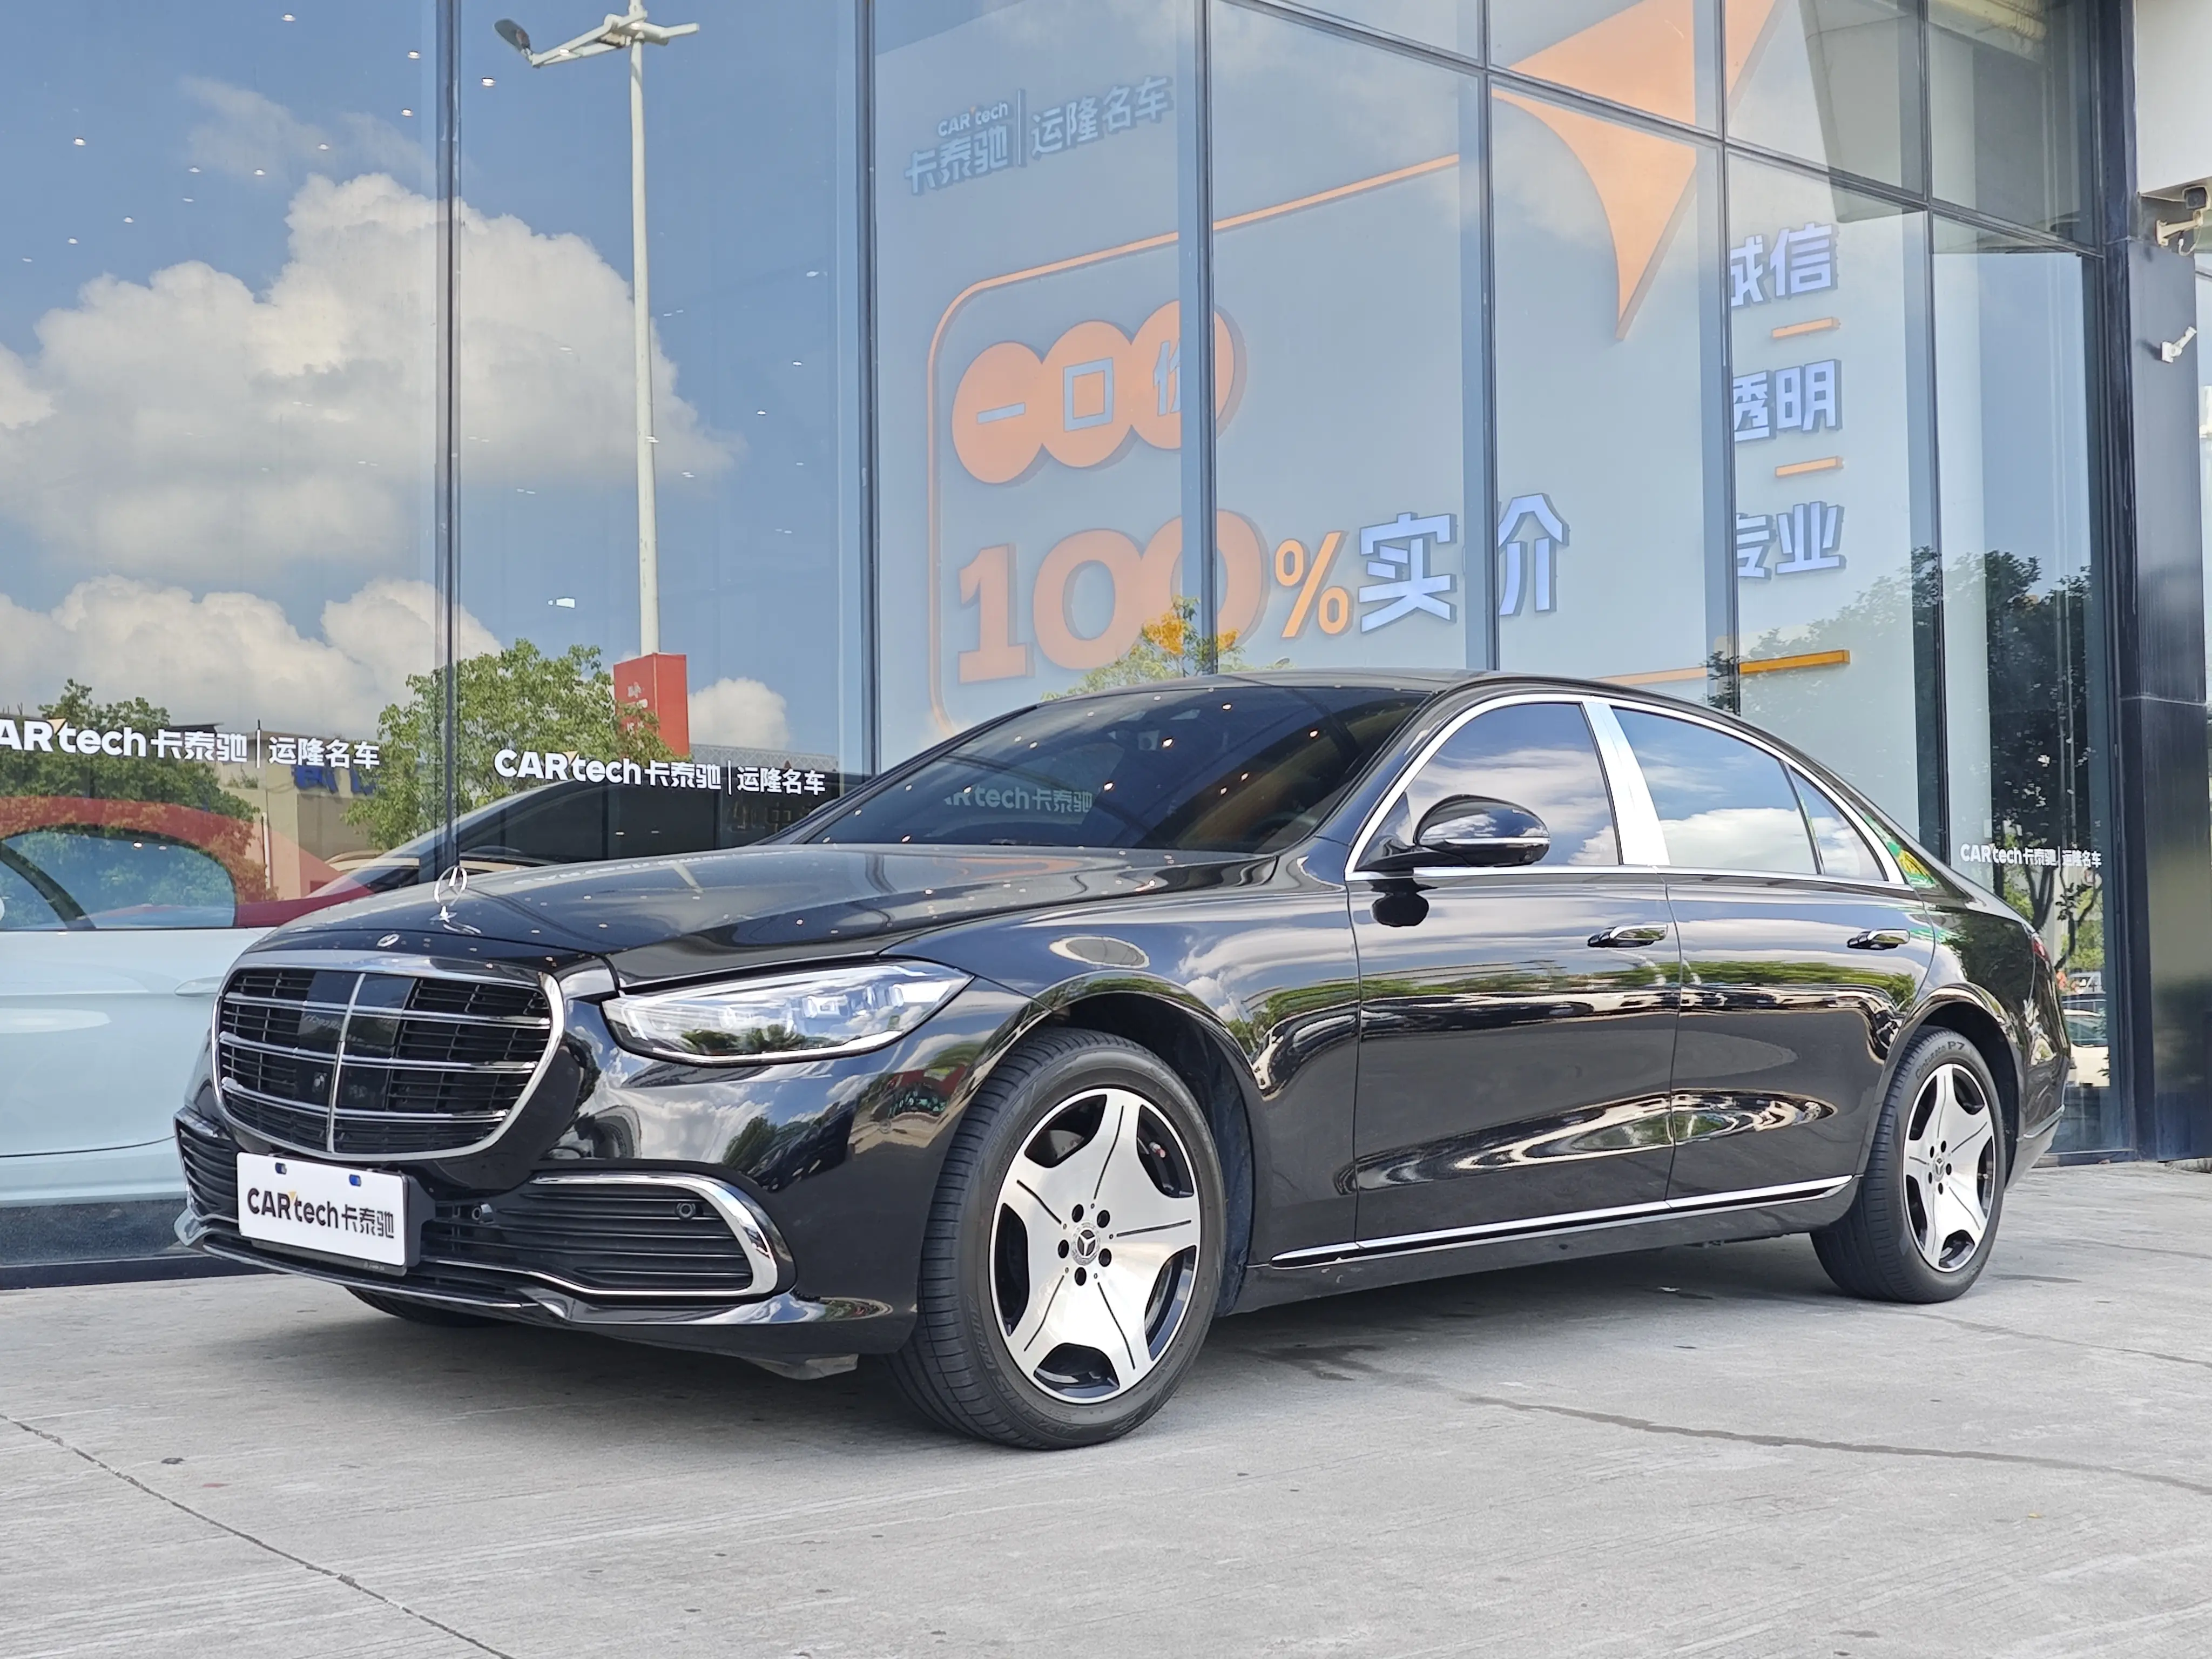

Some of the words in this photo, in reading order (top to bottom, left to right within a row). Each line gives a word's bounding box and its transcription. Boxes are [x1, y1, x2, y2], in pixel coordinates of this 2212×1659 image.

[905, 124, 1009, 195] 卡泰驰
[1030, 76, 1168, 158] 运隆名车
[268, 736, 380, 770] 运隆名车
[737, 766, 826, 797] 运隆名车
[1947, 1041, 1965, 1050] P7
